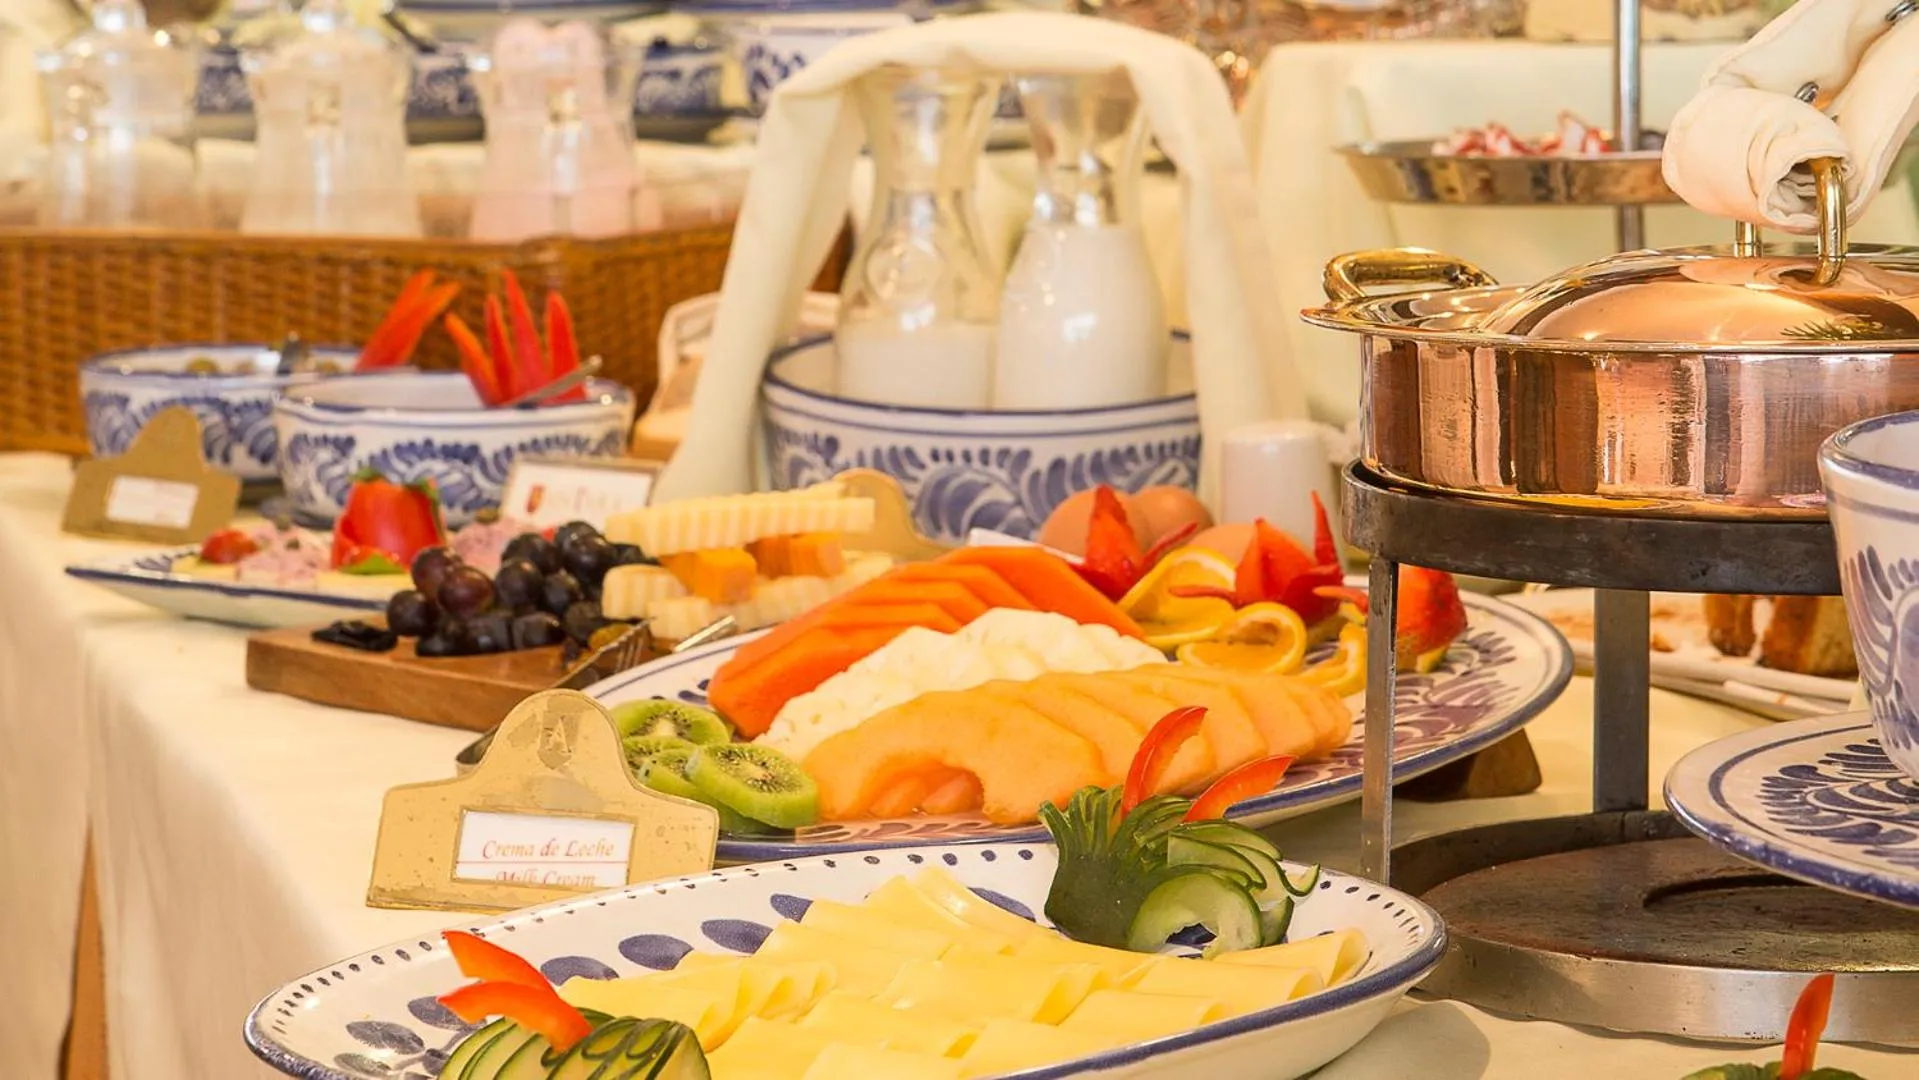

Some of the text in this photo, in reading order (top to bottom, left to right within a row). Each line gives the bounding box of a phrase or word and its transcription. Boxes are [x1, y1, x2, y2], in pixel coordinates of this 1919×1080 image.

[481, 837, 615, 859] Crema de Leche
